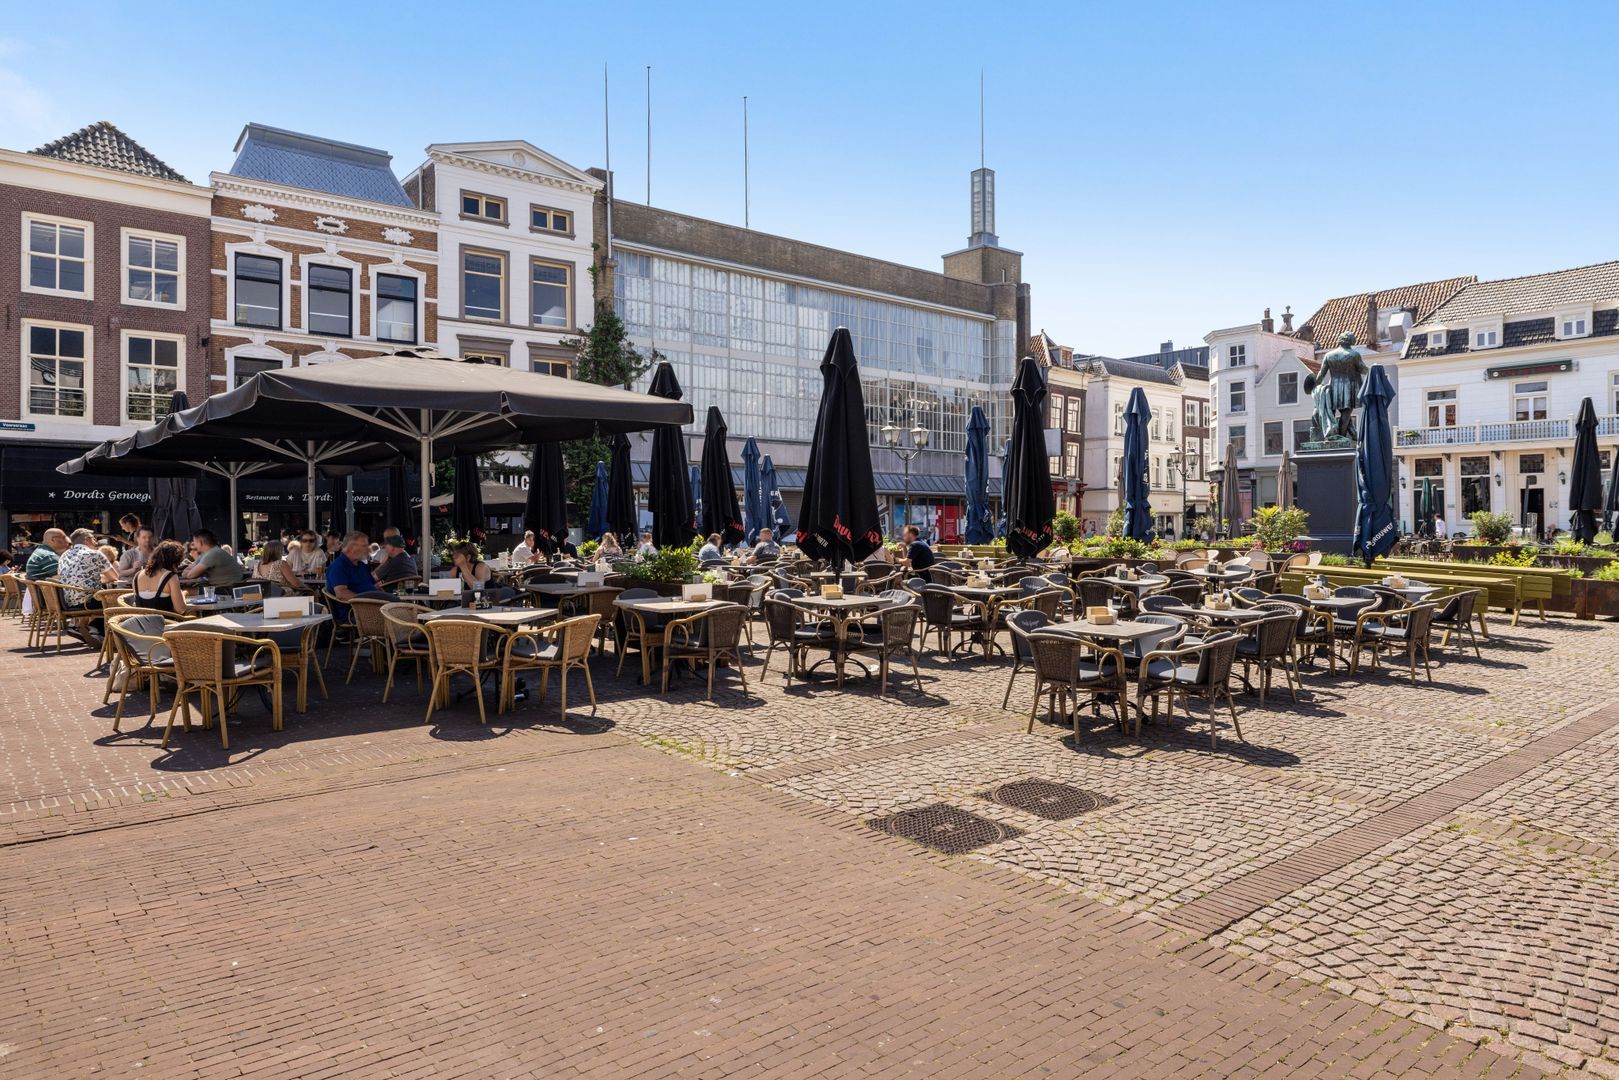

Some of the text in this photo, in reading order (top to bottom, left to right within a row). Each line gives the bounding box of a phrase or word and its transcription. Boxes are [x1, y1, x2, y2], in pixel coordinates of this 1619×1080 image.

[63, 489, 151, 503] Dordts Genoeg
[302, 493, 333, 502] Drdt
